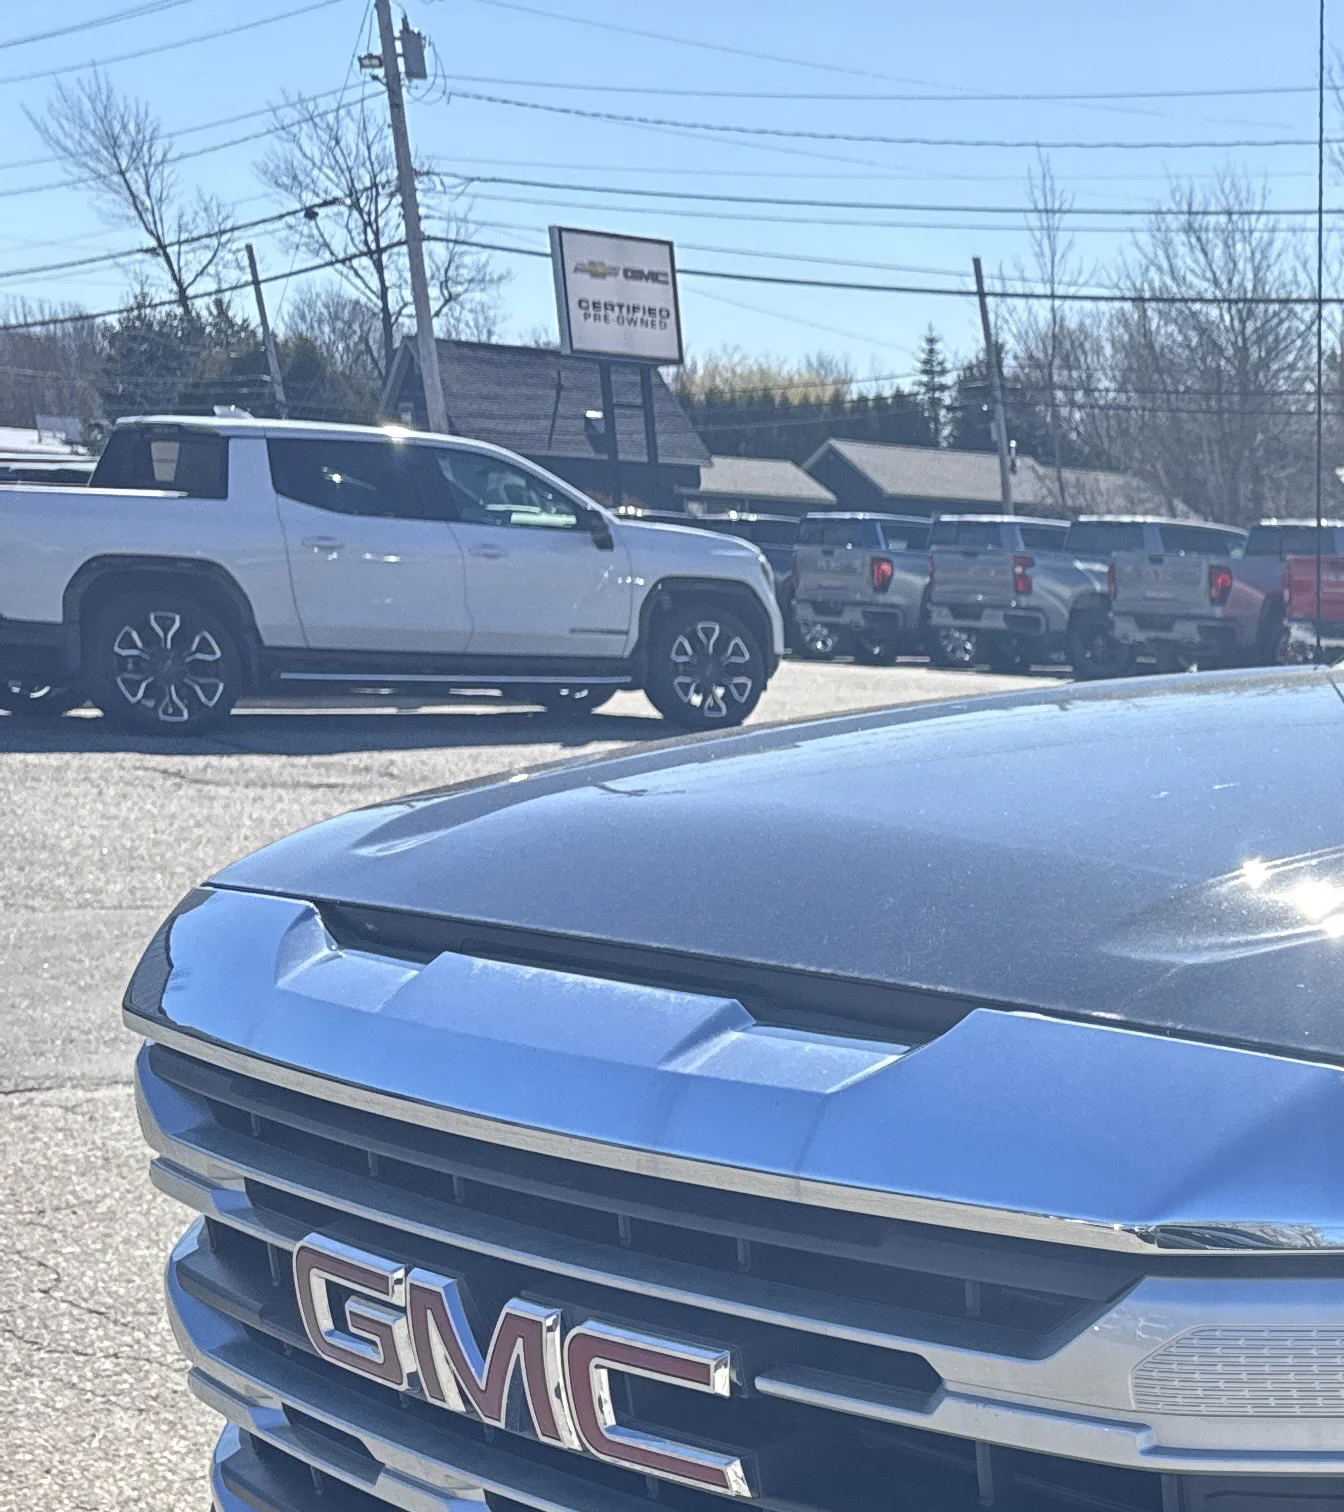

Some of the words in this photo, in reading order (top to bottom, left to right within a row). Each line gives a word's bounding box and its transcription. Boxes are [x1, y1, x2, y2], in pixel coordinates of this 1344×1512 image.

[623, 266, 670, 286] GMC
[578, 299, 671, 321] CERTIFIED
[293, 1232, 752, 1498] GMC
